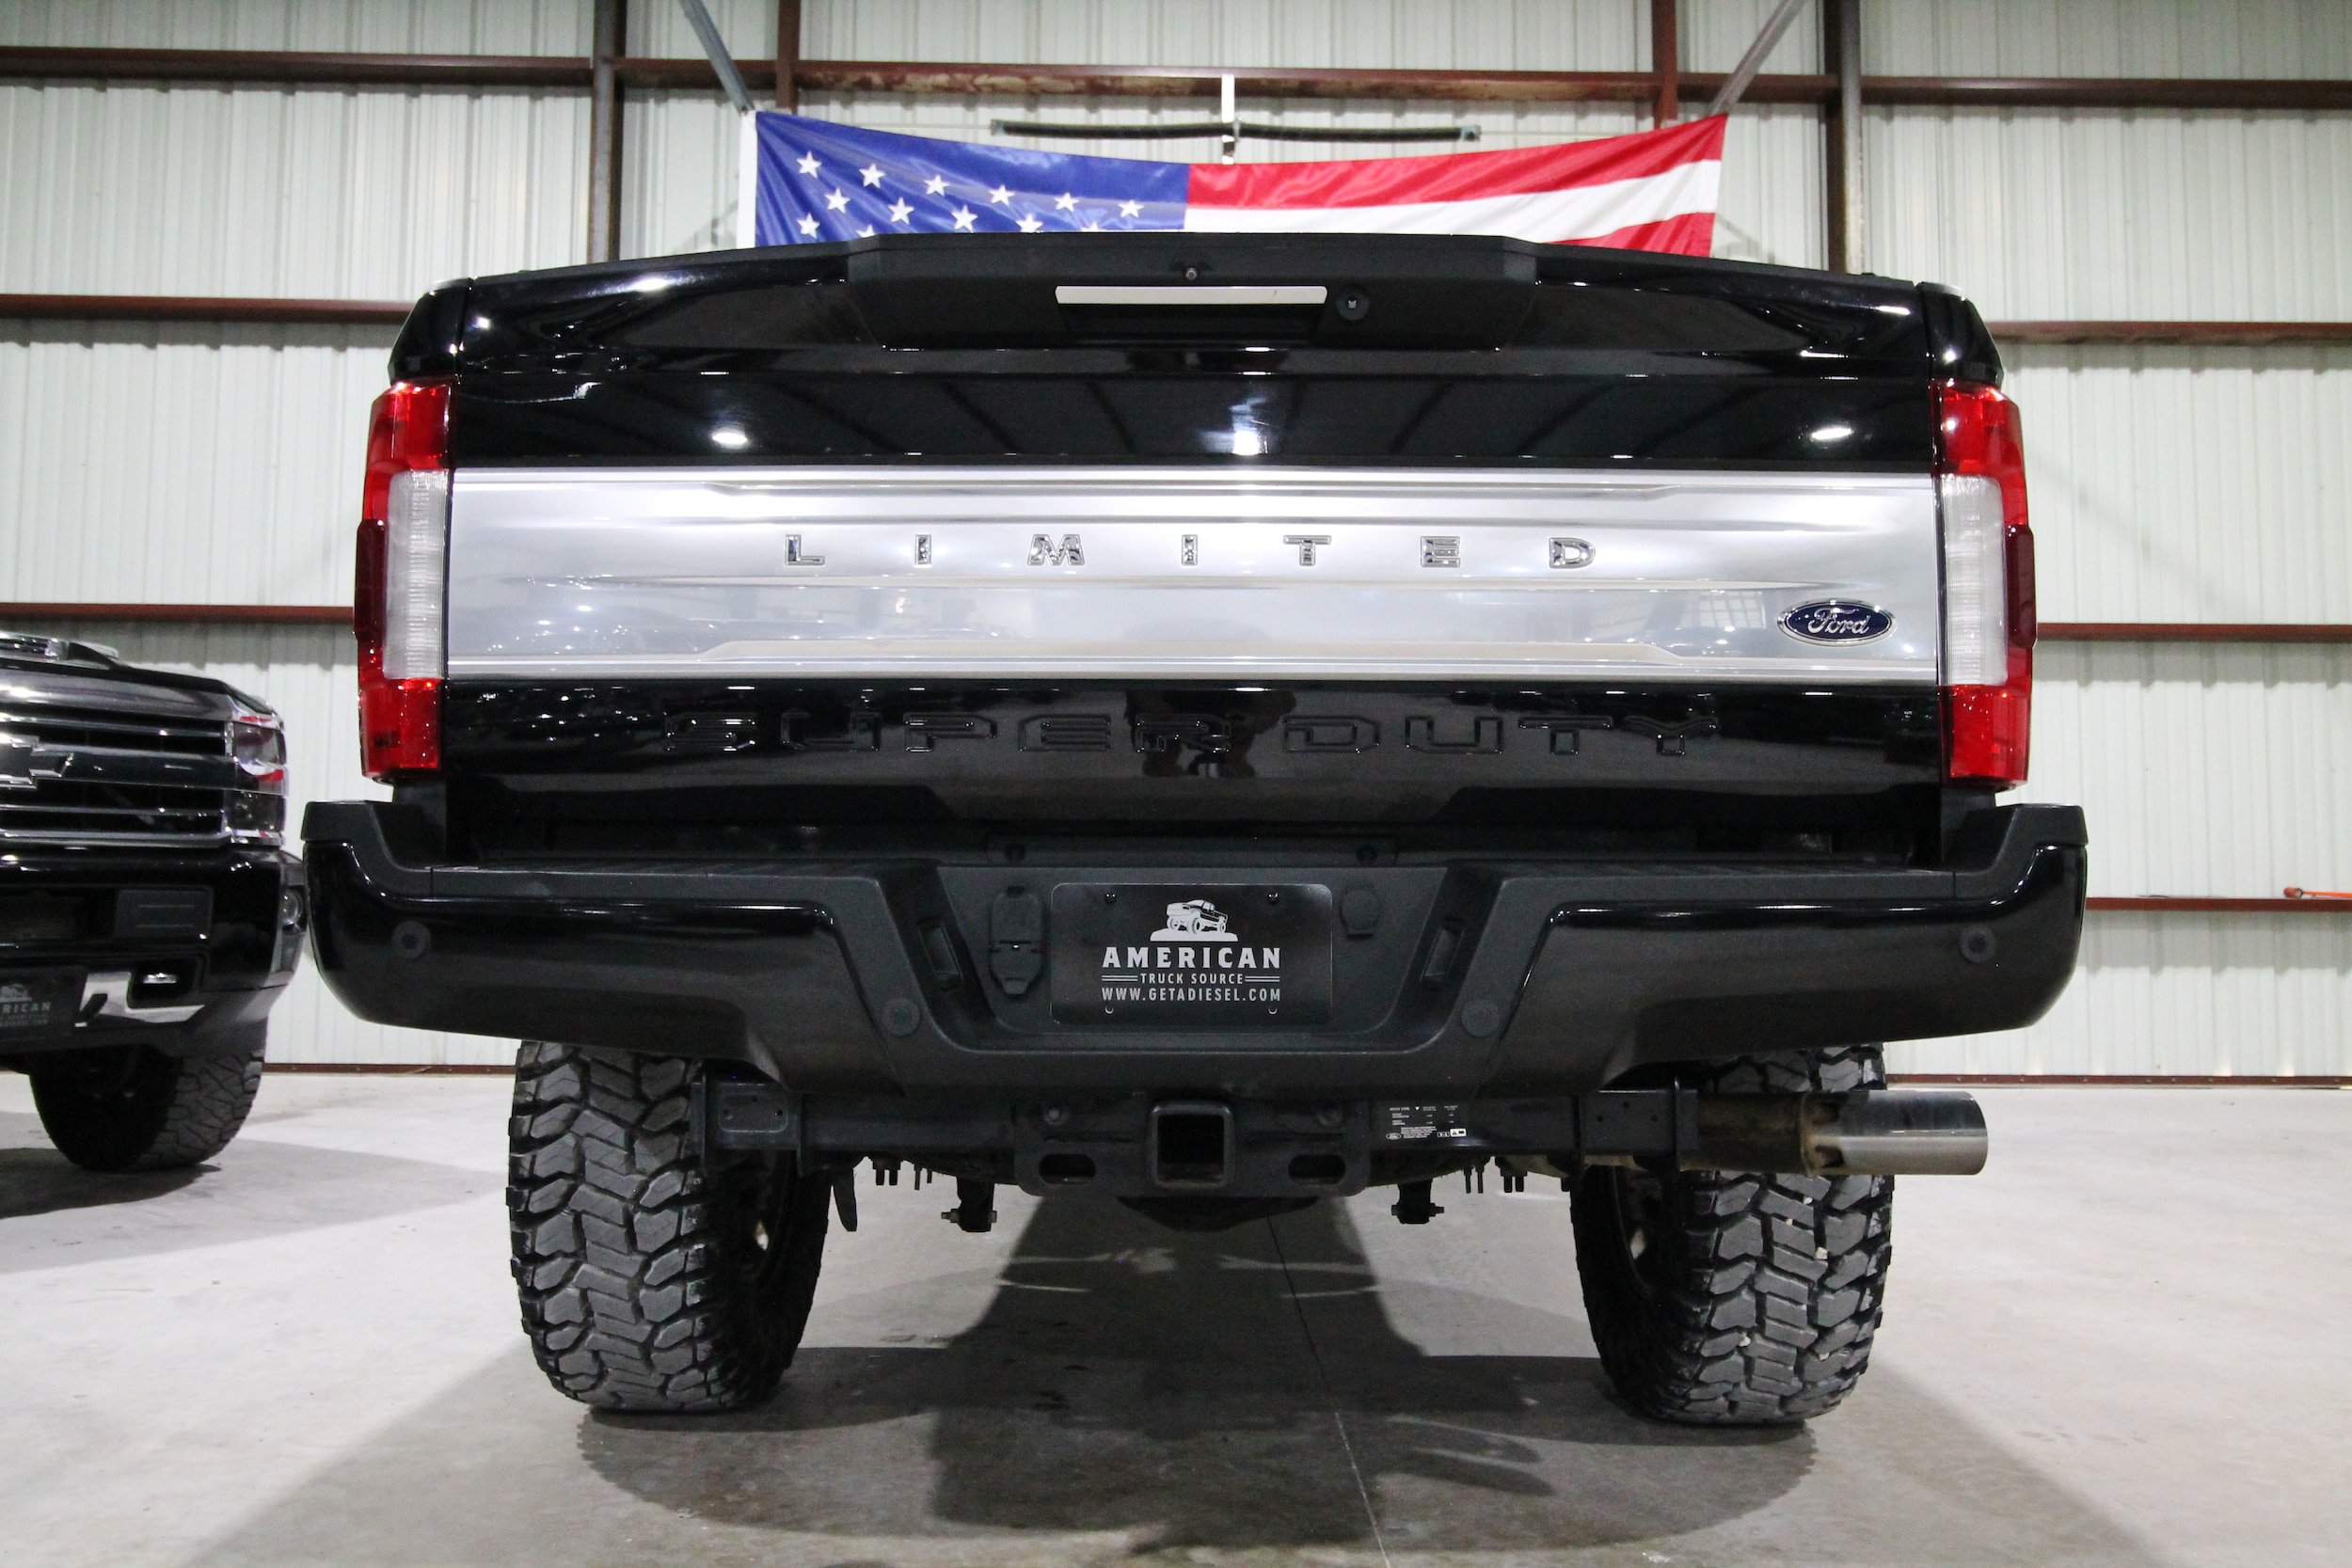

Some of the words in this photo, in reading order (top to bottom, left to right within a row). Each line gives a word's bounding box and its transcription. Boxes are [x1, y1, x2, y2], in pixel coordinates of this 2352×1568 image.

[785, 534, 1597, 566] LIMITED
[1807, 607, 1871, 635] Ford
[664, 711, 1232, 753] SUPER
[1282, 715, 1720, 755] DUTY
[1102, 946, 1280, 969] AMERICAN
[1140, 973, 1184, 985] TRUCK
[1191, 973, 1244, 985] SOURCE
[1102, 988, 1281, 1002] WWW.GETADIESEL.COM
